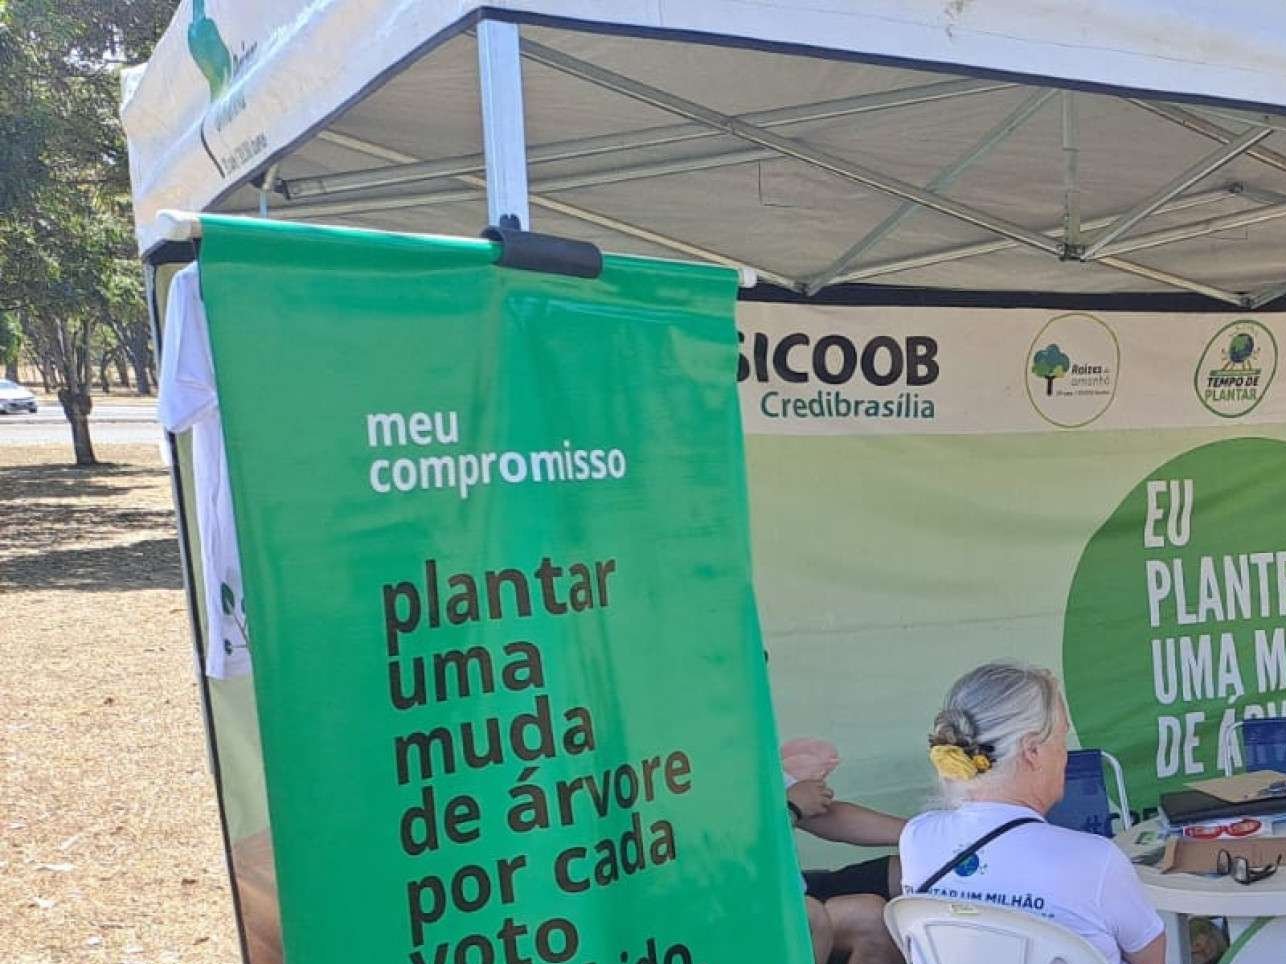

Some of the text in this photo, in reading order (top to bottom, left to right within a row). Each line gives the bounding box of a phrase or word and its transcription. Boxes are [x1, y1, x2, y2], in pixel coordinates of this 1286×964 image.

[761, 390, 935, 419] Credibrasília
[1205, 388, 1257, 401] PLANTAR
[1207, 377, 1243, 388] TEMPO
[366, 410, 460, 447] meu
[370, 440, 627, 499] compromisso
[1144, 478, 1193, 548] EU
[382, 557, 616, 656] plantar
[388, 641, 545, 710] uma
[1152, 633, 1244, 704] UMA
[393, 694, 596, 786] muda
[1156, 712, 1205, 779] DE
[400, 749, 692, 856] de árvore
[407, 811, 677, 947] por cada
[985, 893, 1045, 910] MILHÃO
